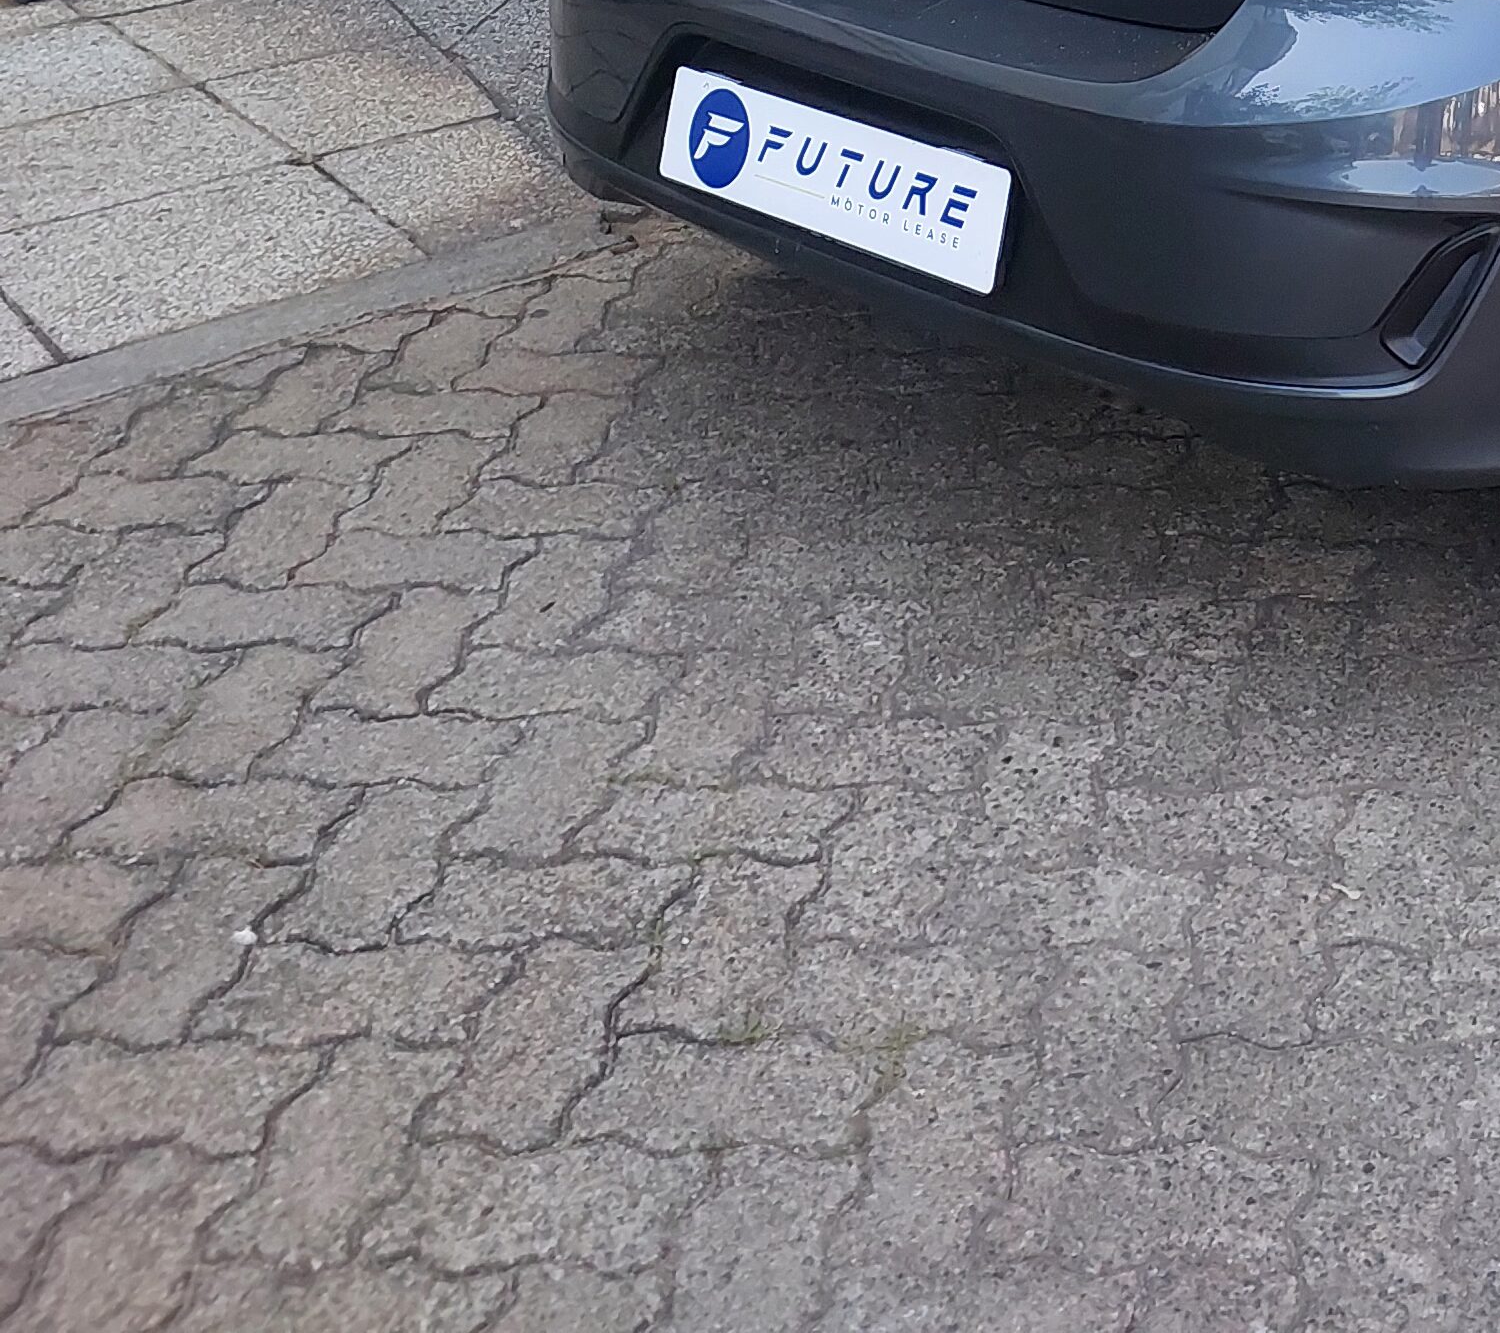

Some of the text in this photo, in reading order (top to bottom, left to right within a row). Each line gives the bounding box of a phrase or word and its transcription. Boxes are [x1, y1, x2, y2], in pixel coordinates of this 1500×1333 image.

[757, 125, 978, 230] FUTURE
[830, 195, 961, 249] MOTOR LEASE
